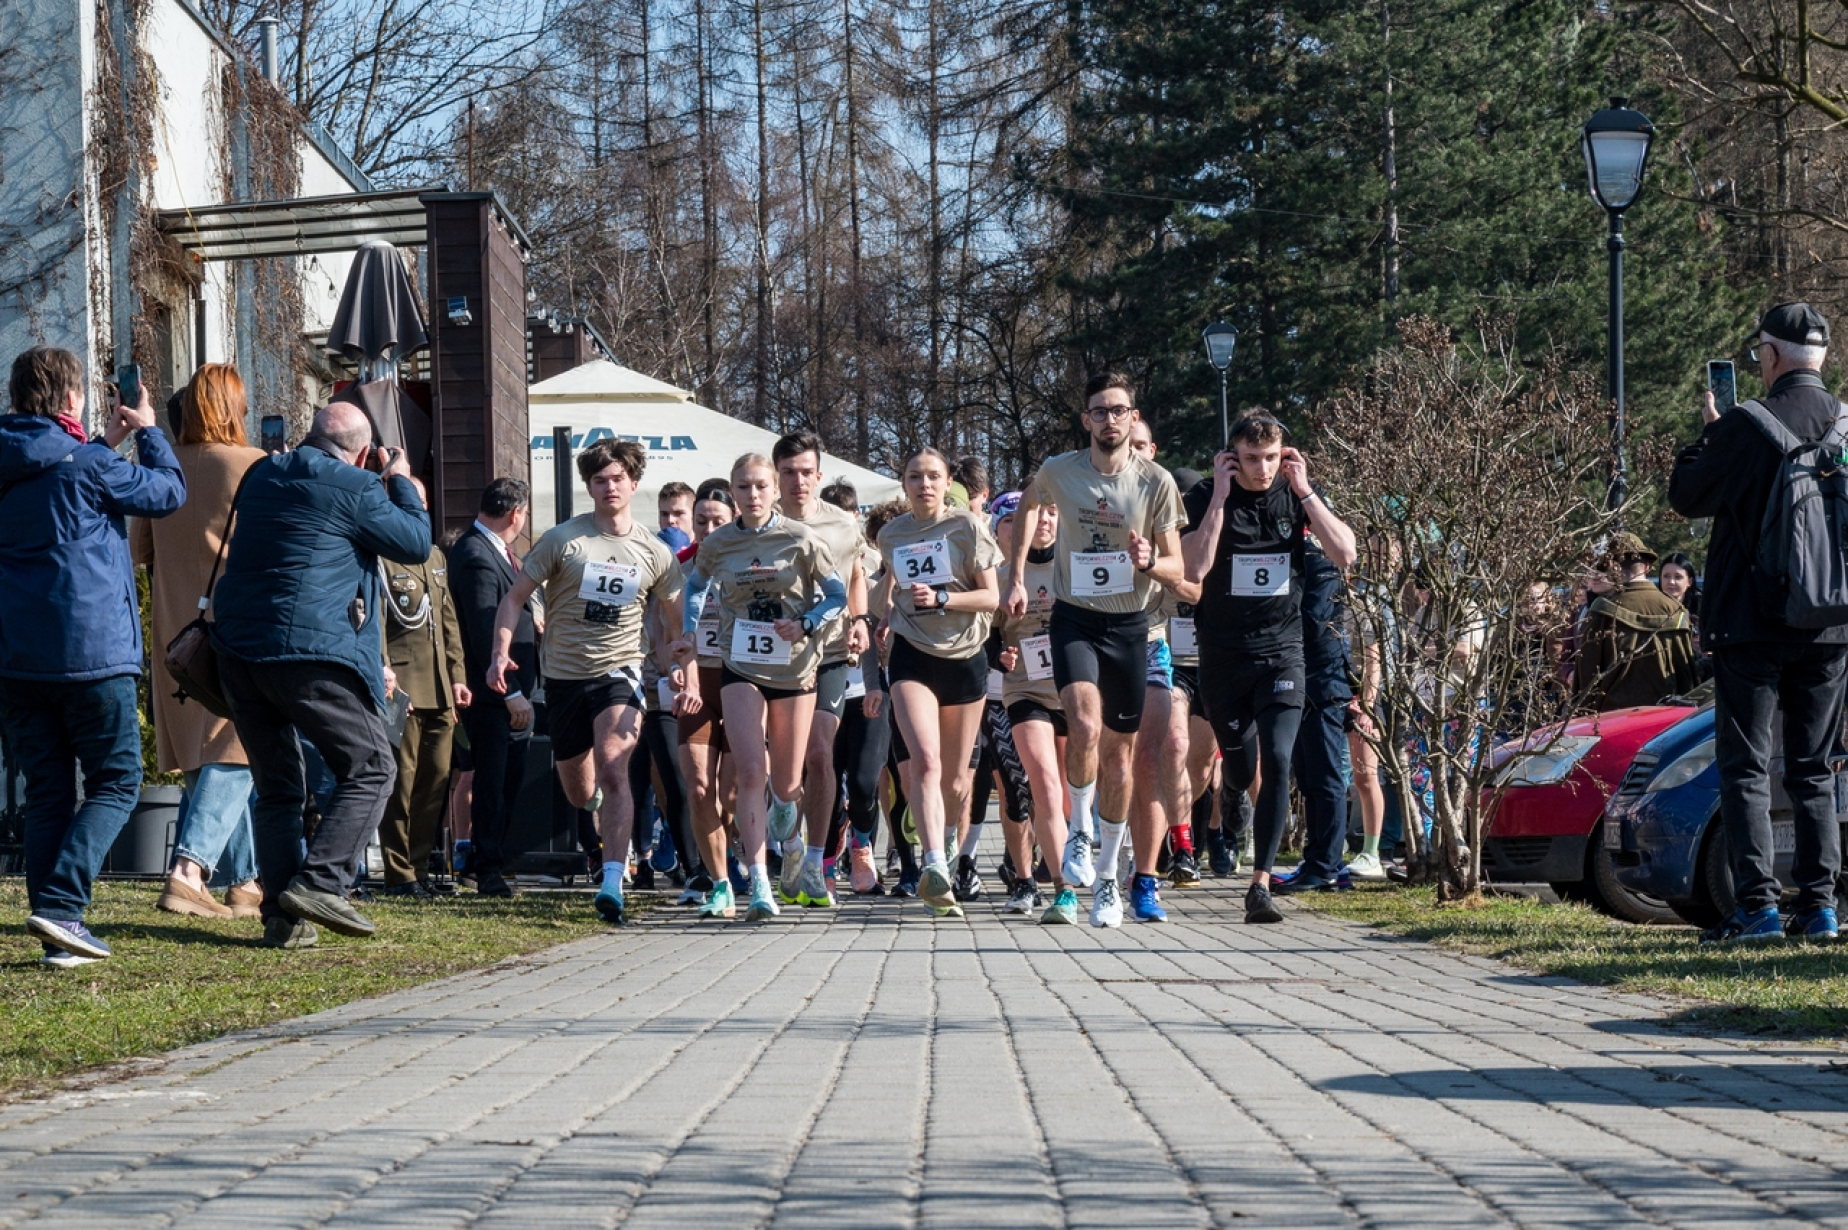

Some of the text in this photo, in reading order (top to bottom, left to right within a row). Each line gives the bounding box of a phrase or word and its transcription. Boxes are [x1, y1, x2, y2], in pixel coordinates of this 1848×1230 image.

[906, 556, 936, 578] 34
[1092, 567, 1109, 586] 9
[1254, 567, 1269, 586] 8
[596, 576, 624, 595] 16
[705, 631, 718, 647] 2
[747, 635, 774, 654] 13
[1037, 649, 1052, 668] 1
